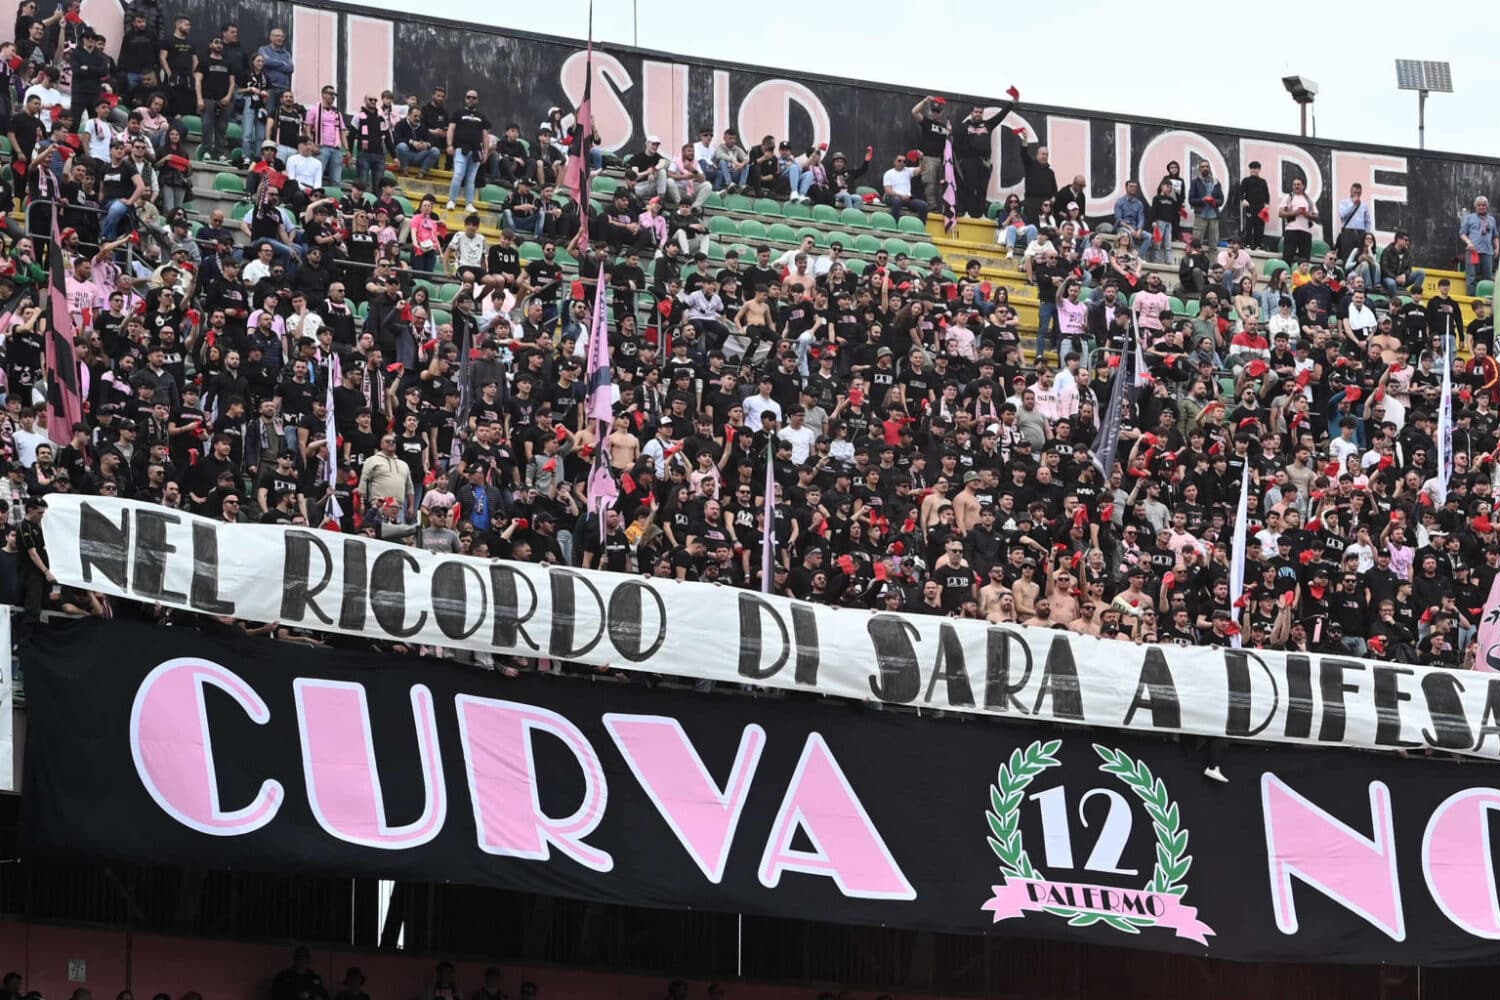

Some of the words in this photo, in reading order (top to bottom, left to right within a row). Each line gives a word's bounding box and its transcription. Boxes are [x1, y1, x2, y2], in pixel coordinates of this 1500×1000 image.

[560, 50, 831, 162] SUO
[964, 106, 1408, 247] CUORE
[80, 501, 235, 615] NEL
[280, 529, 667, 663] RICORDO
[738, 592, 820, 686] DI
[869, 614, 1084, 720] SARA
[1123, 647, 1182, 729] A
[130, 656, 918, 901] CURVA
[1029, 785, 1139, 876] 12
[1026, 882, 1166, 918] PALERMO
